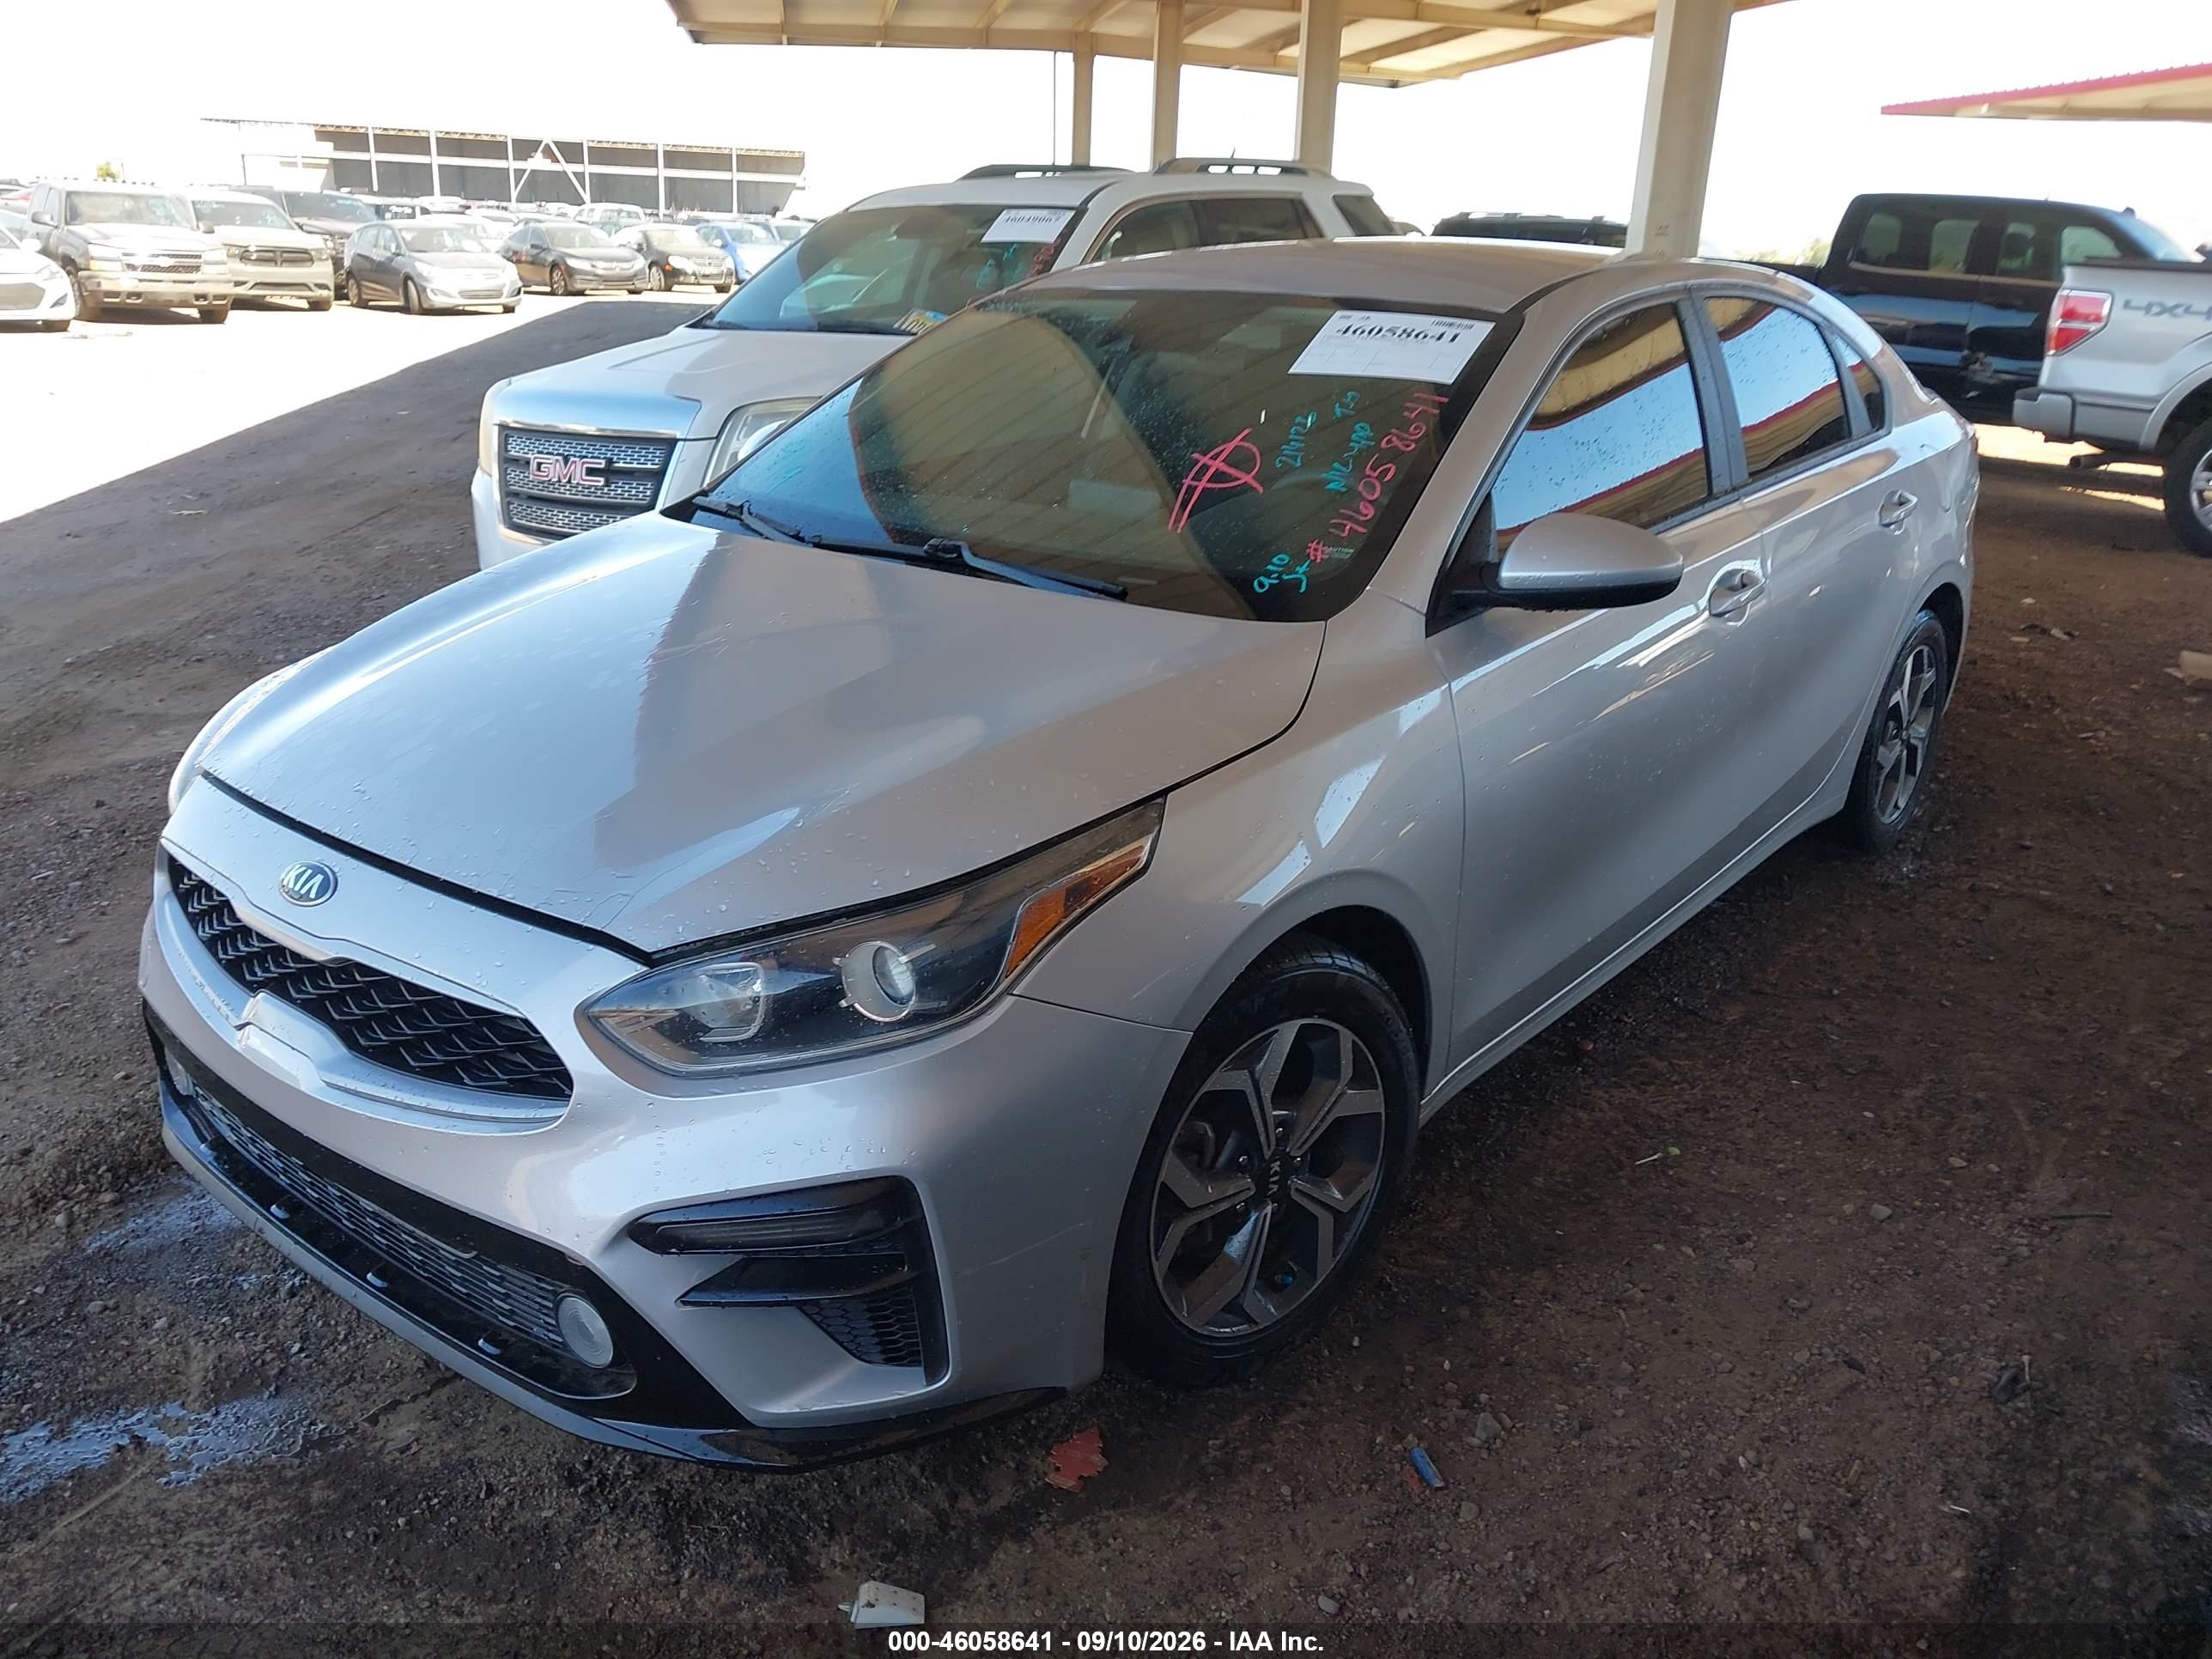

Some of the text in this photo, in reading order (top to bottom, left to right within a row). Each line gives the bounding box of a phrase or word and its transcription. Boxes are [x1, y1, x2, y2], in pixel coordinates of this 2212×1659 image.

[1336, 322, 1462, 343] 46058641
[530, 453, 606, 487] GMC
[283, 864, 325, 899] KIA
